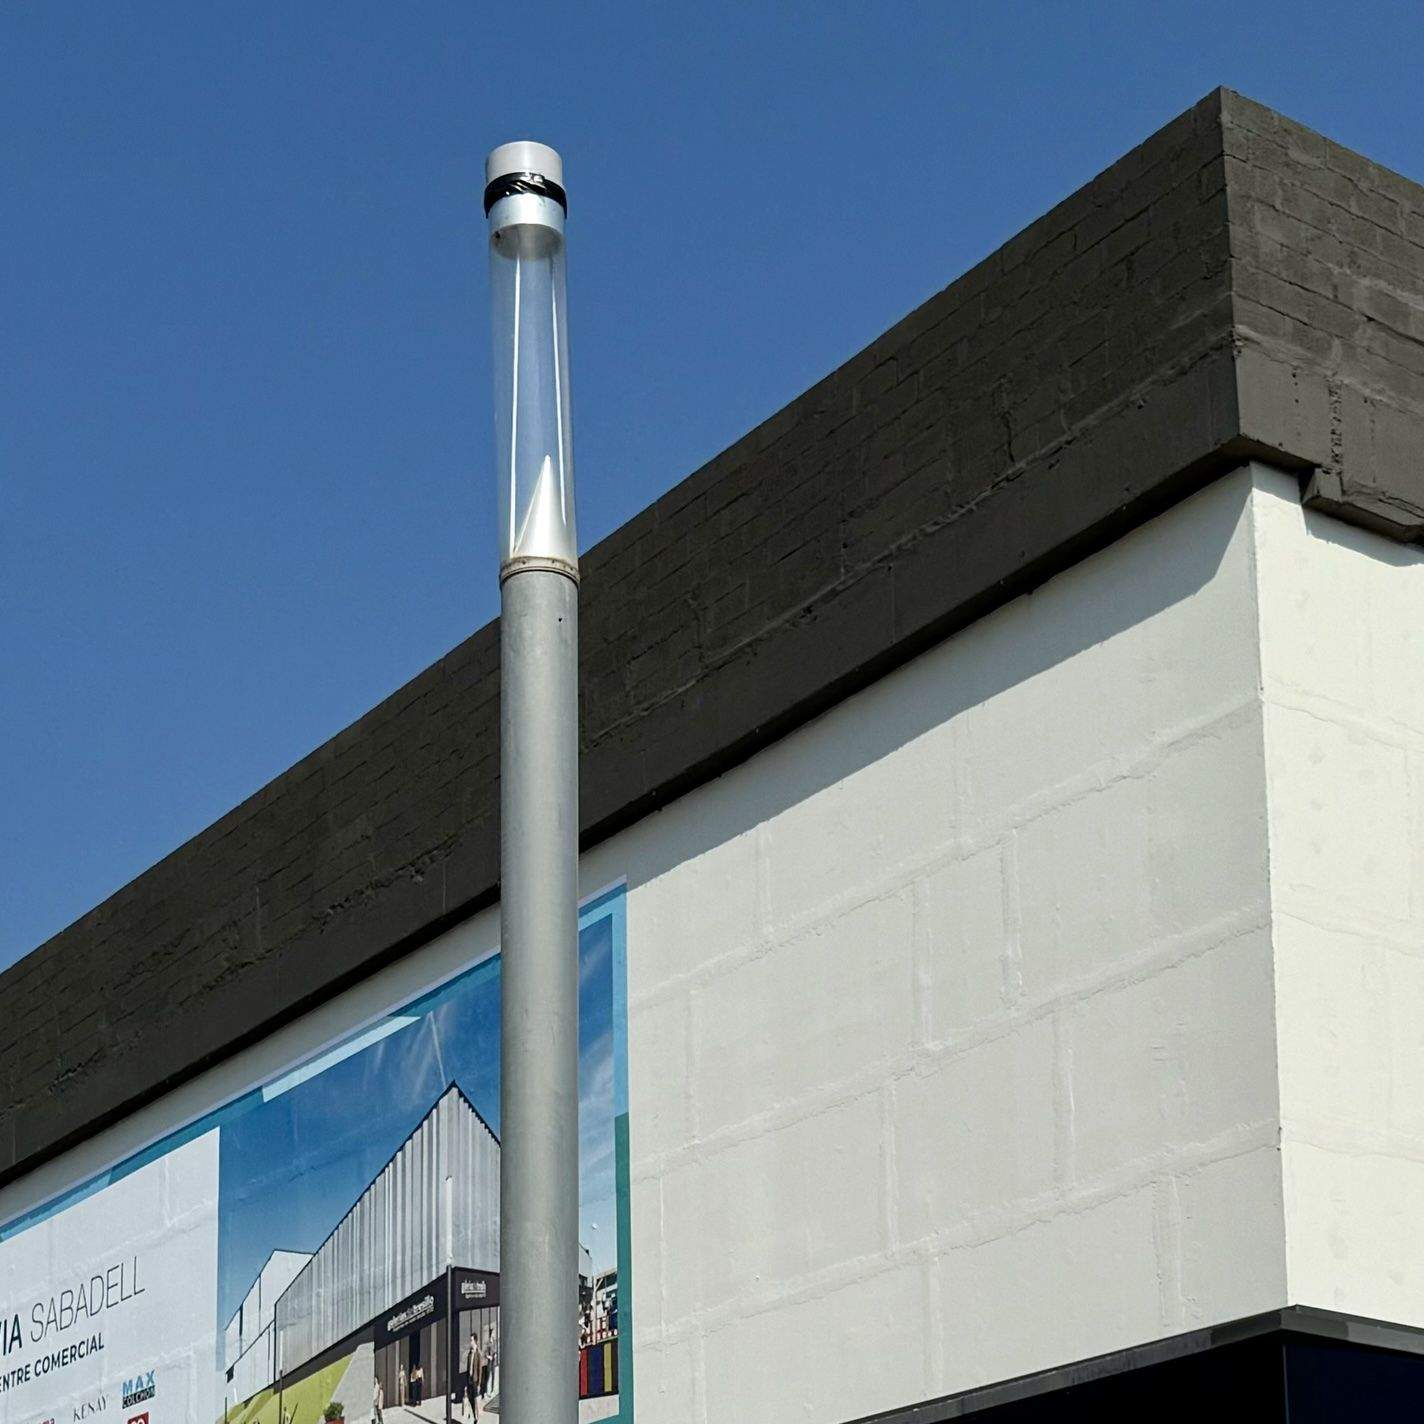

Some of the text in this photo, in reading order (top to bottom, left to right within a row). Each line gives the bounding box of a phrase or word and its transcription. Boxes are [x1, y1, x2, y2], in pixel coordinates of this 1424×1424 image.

[31, 1256, 146, 1342] SABADELL
[34, 1332, 105, 1377] COMERCIAL
[122, 1369, 155, 1396] MAX
